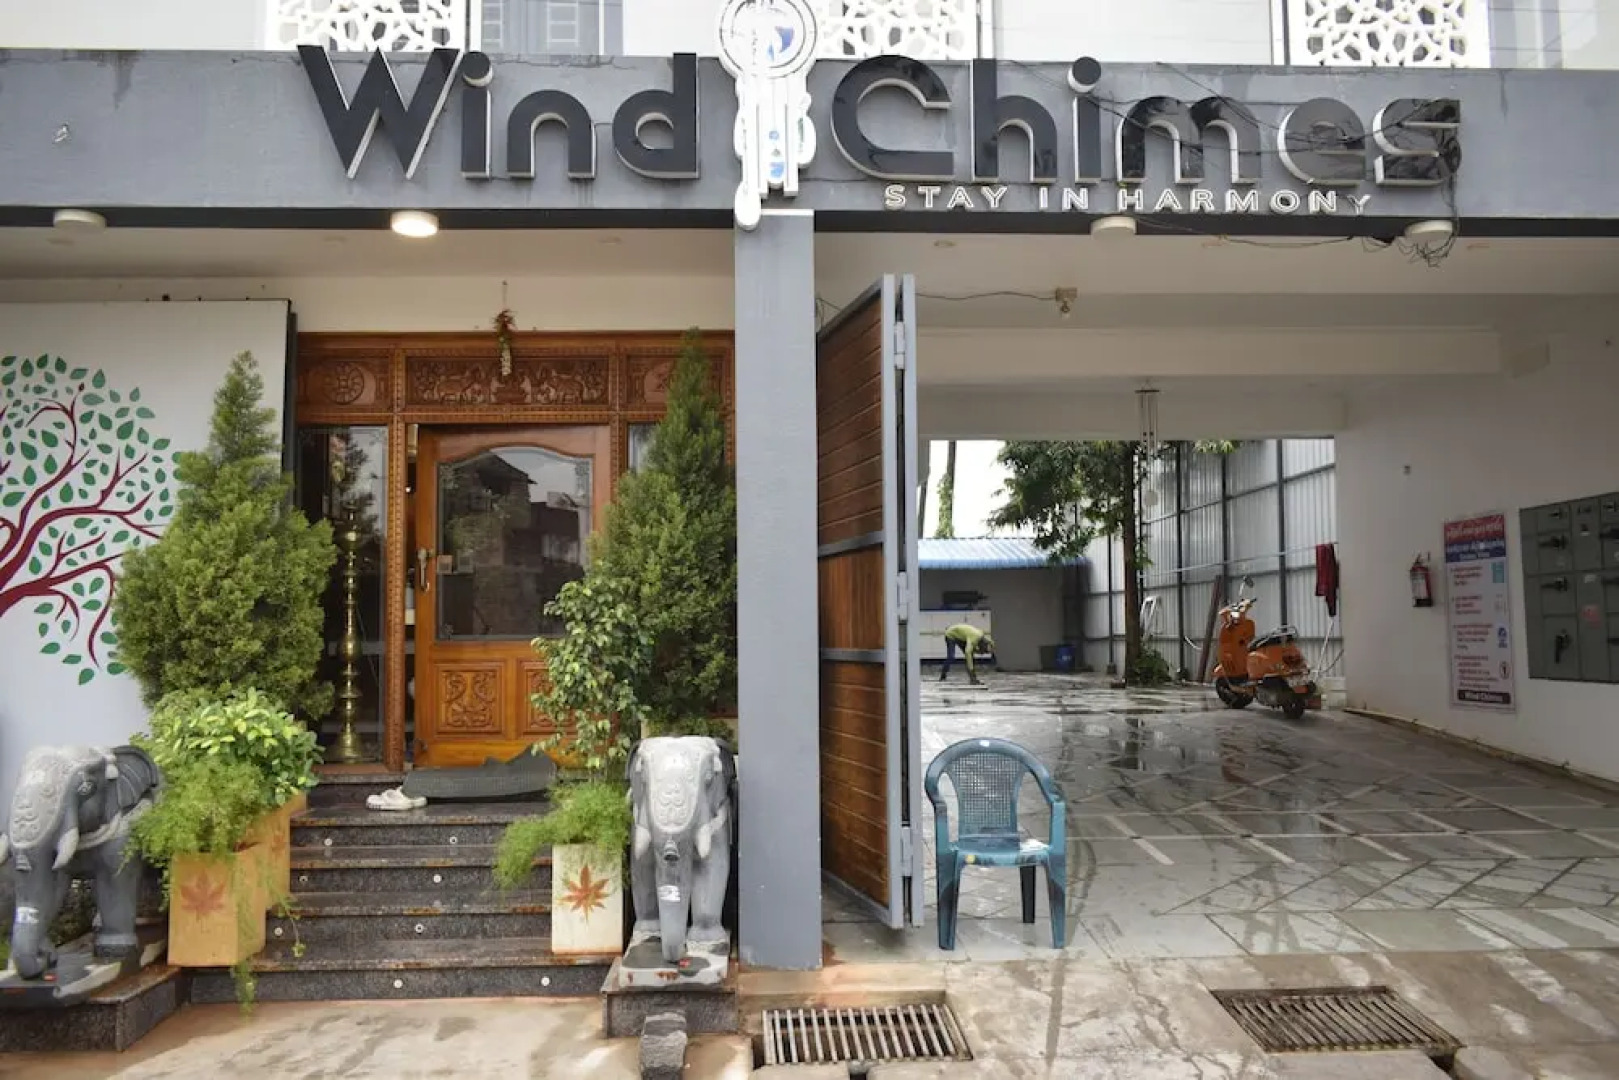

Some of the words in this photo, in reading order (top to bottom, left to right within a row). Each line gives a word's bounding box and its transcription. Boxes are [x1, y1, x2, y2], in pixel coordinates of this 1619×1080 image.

[297, 45, 700, 180] Wind
[830, 55, 1461, 186] Chimes
[884, 185, 1007, 210] STAY
[1039, 188, 1090, 211] IN
[1118, 189, 1372, 215] HARMONY
